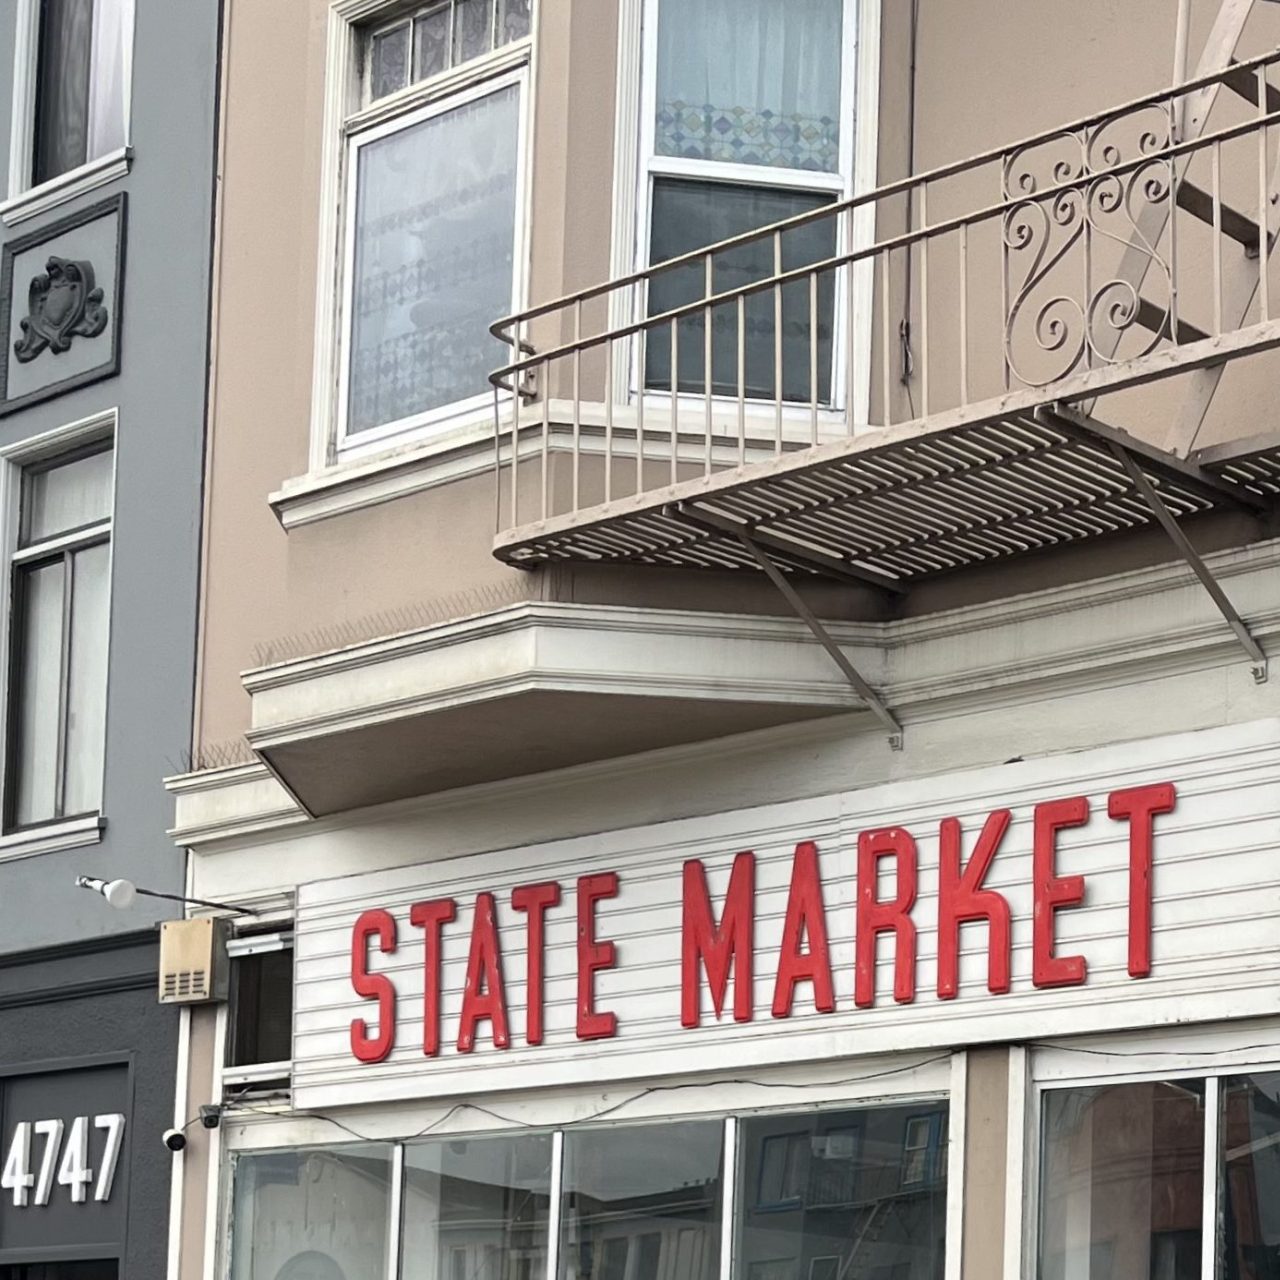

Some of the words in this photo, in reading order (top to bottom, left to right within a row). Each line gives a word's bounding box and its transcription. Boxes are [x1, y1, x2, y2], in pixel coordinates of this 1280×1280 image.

[351, 870, 619, 1064] STATE
[680, 781, 1177, 1029] MARKET
[1, 1113, 125, 1207] 4747
